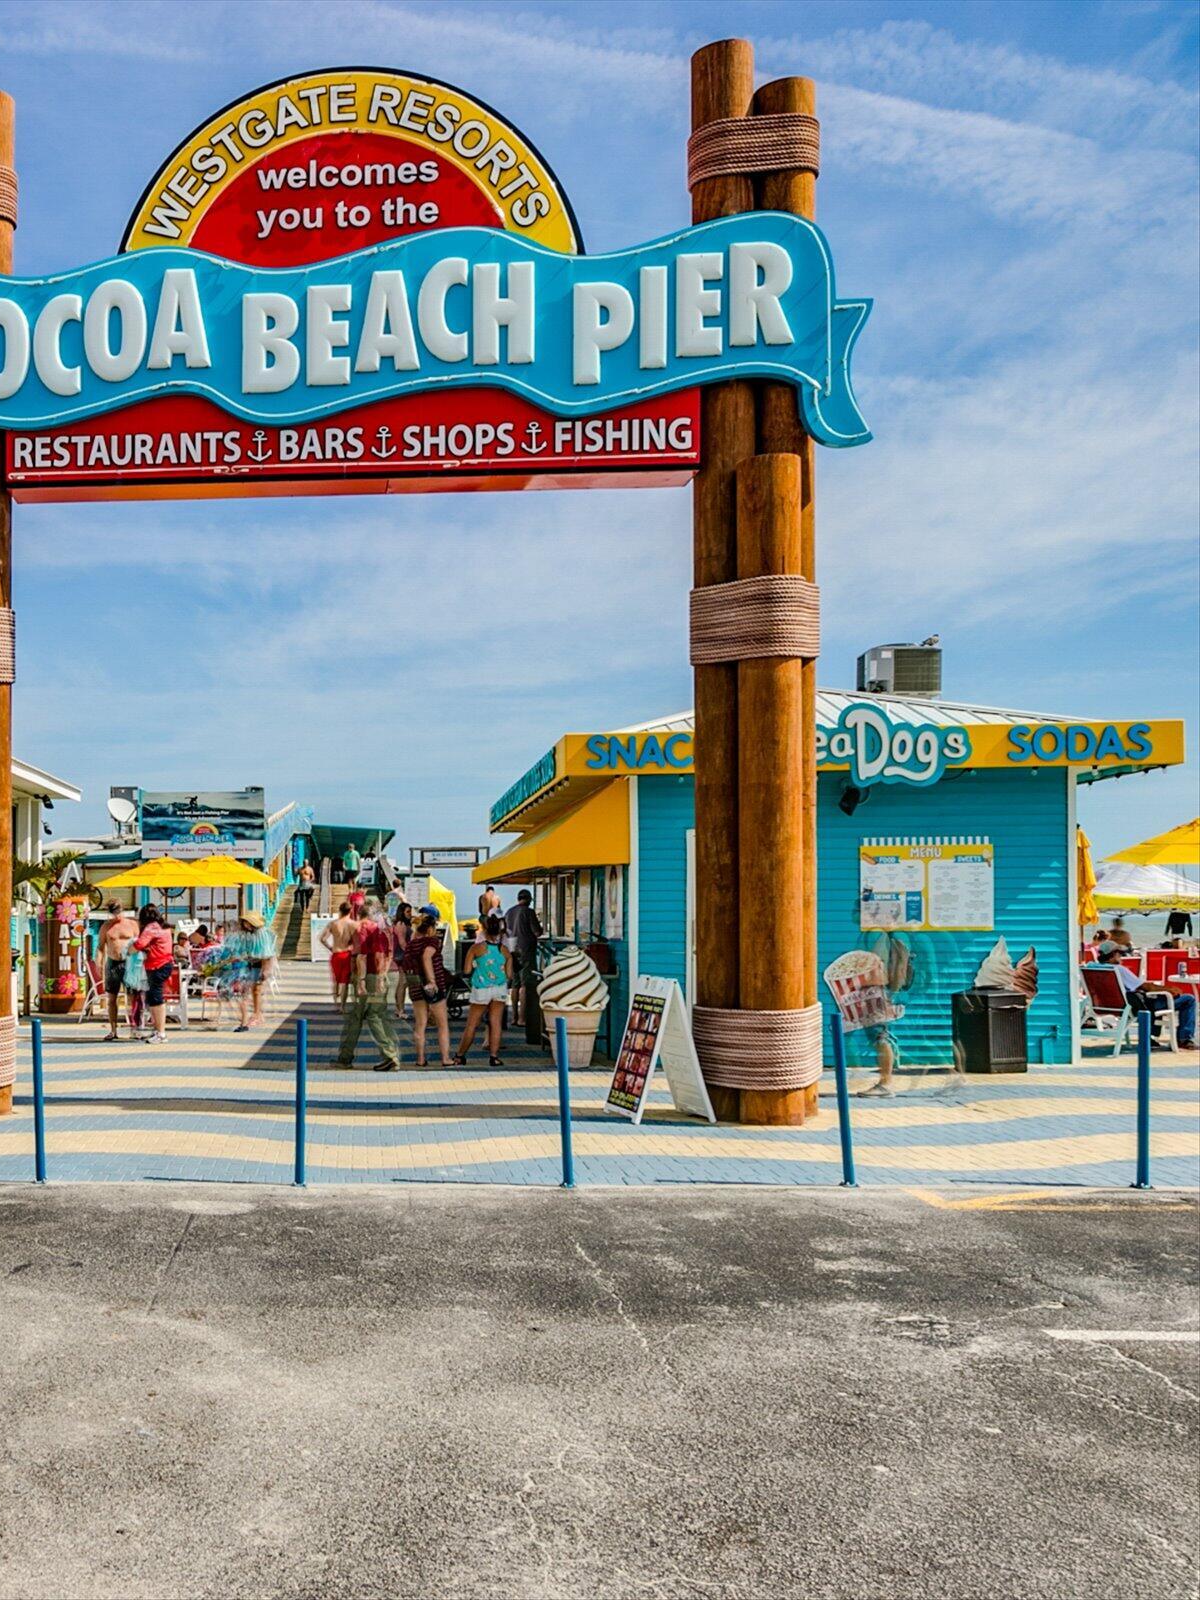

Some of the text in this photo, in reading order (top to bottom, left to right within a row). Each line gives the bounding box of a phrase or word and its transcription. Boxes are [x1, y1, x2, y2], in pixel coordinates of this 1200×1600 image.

[143, 83, 550, 239] WESTGATE RESORTS
[257, 159, 439, 190] welcomes
[257, 197, 439, 238] you to the
[242, 256, 535, 394] BEACH
[572, 241, 795, 386] PIER
[13, 416, 692, 468] RESTAURANTS BARS SHOPS FISHING
[586, 733, 694, 769] SNAC
[1007, 723, 1153, 762] SODAS
[910, 847, 942, 858] MENU
[59, 924, 71, 971] ATM
